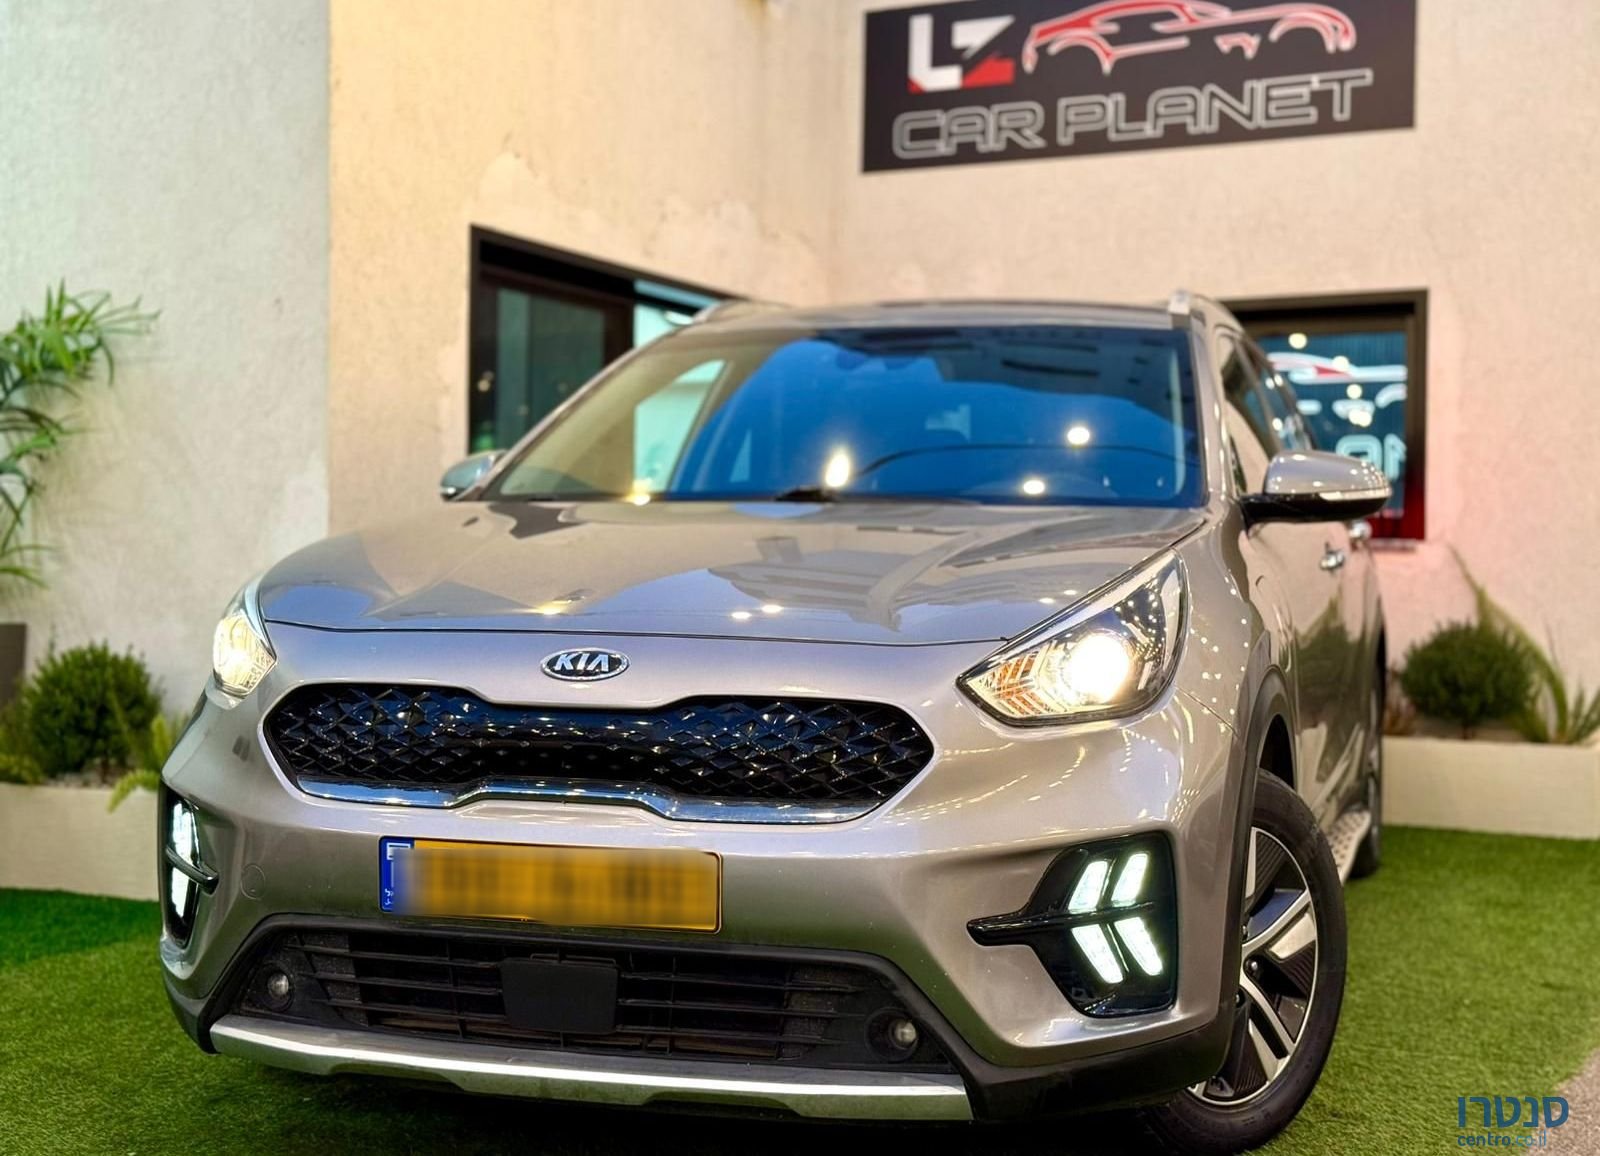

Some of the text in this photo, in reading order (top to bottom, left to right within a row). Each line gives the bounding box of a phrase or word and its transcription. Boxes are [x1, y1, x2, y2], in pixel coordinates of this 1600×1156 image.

[893, 68, 1373, 159] CAR PLANET
[554, 652, 610, 672] KIA
